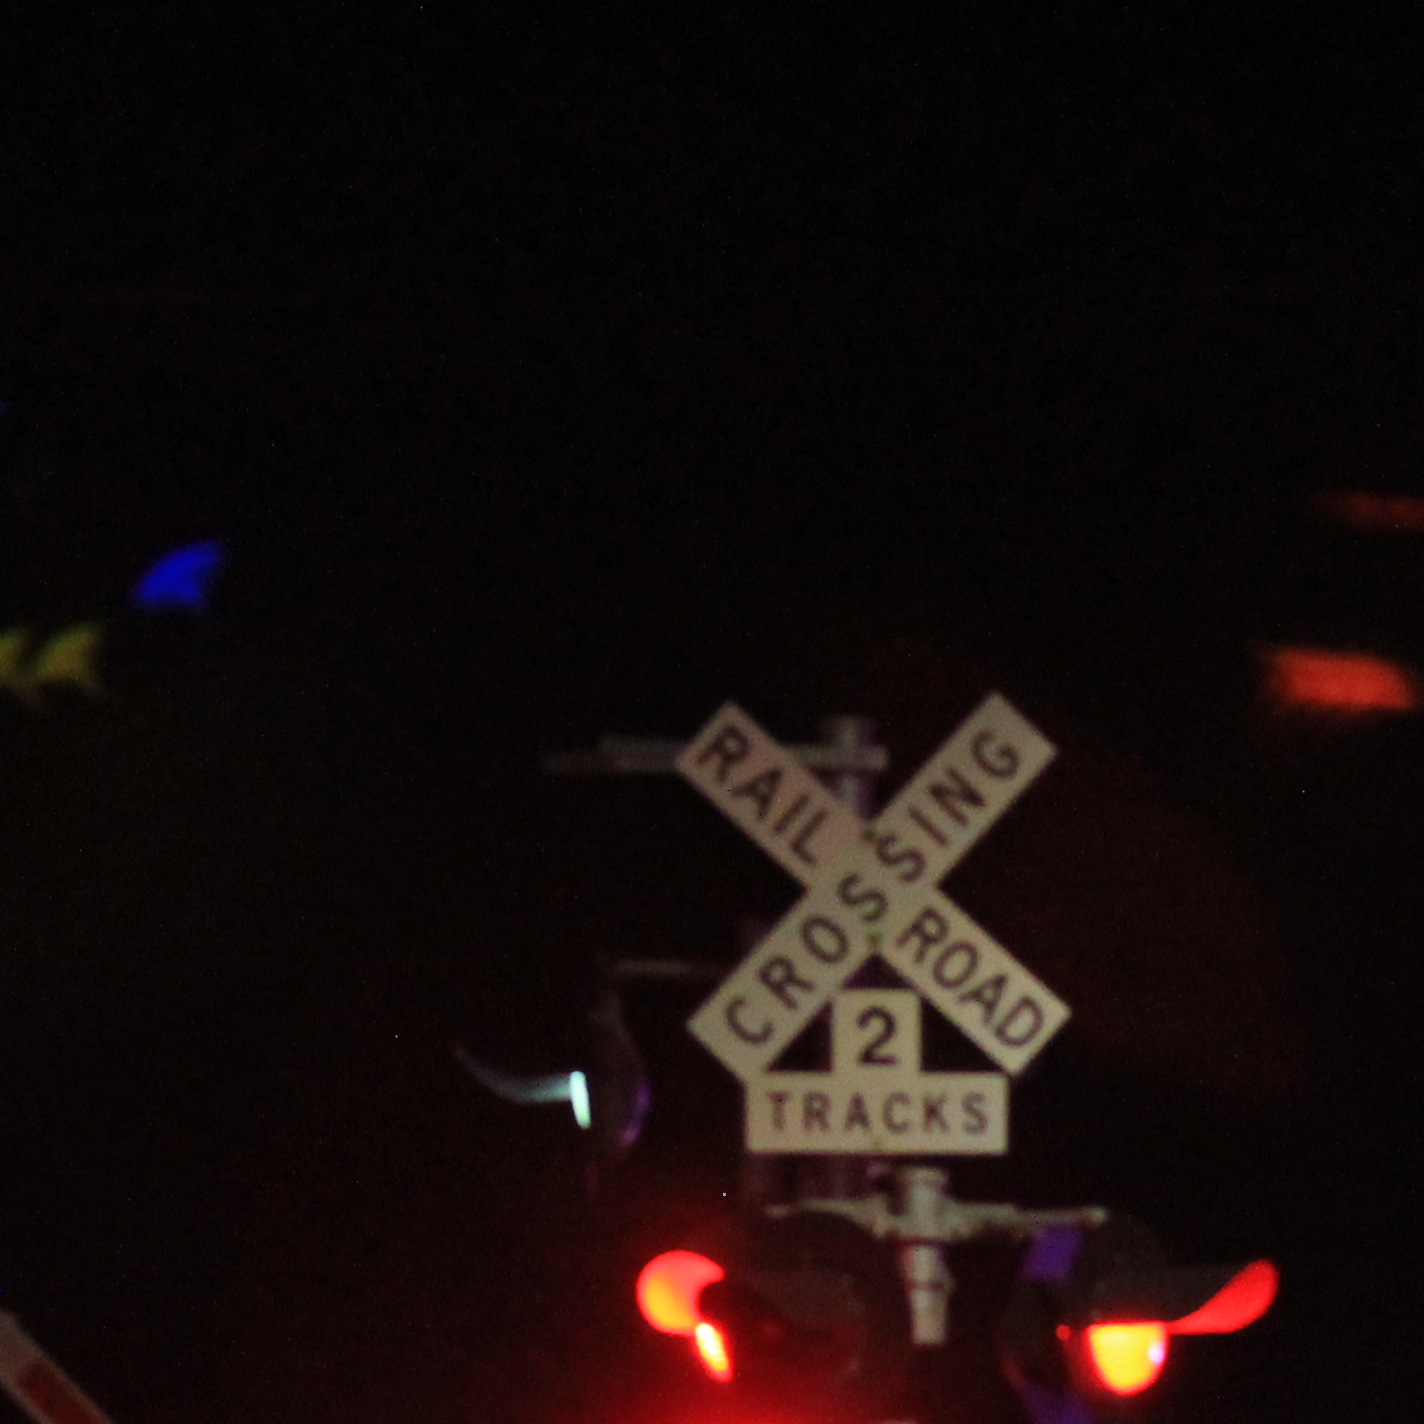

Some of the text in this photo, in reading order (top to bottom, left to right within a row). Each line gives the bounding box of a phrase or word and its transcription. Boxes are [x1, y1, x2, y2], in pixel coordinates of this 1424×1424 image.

[696, 722, 1044, 1049] RAIL ROAD
[723, 729, 1021, 1044] CROSSING
[766, 1090, 990, 1136] TRACKS
[857, 1008, 898, 1066] 2
